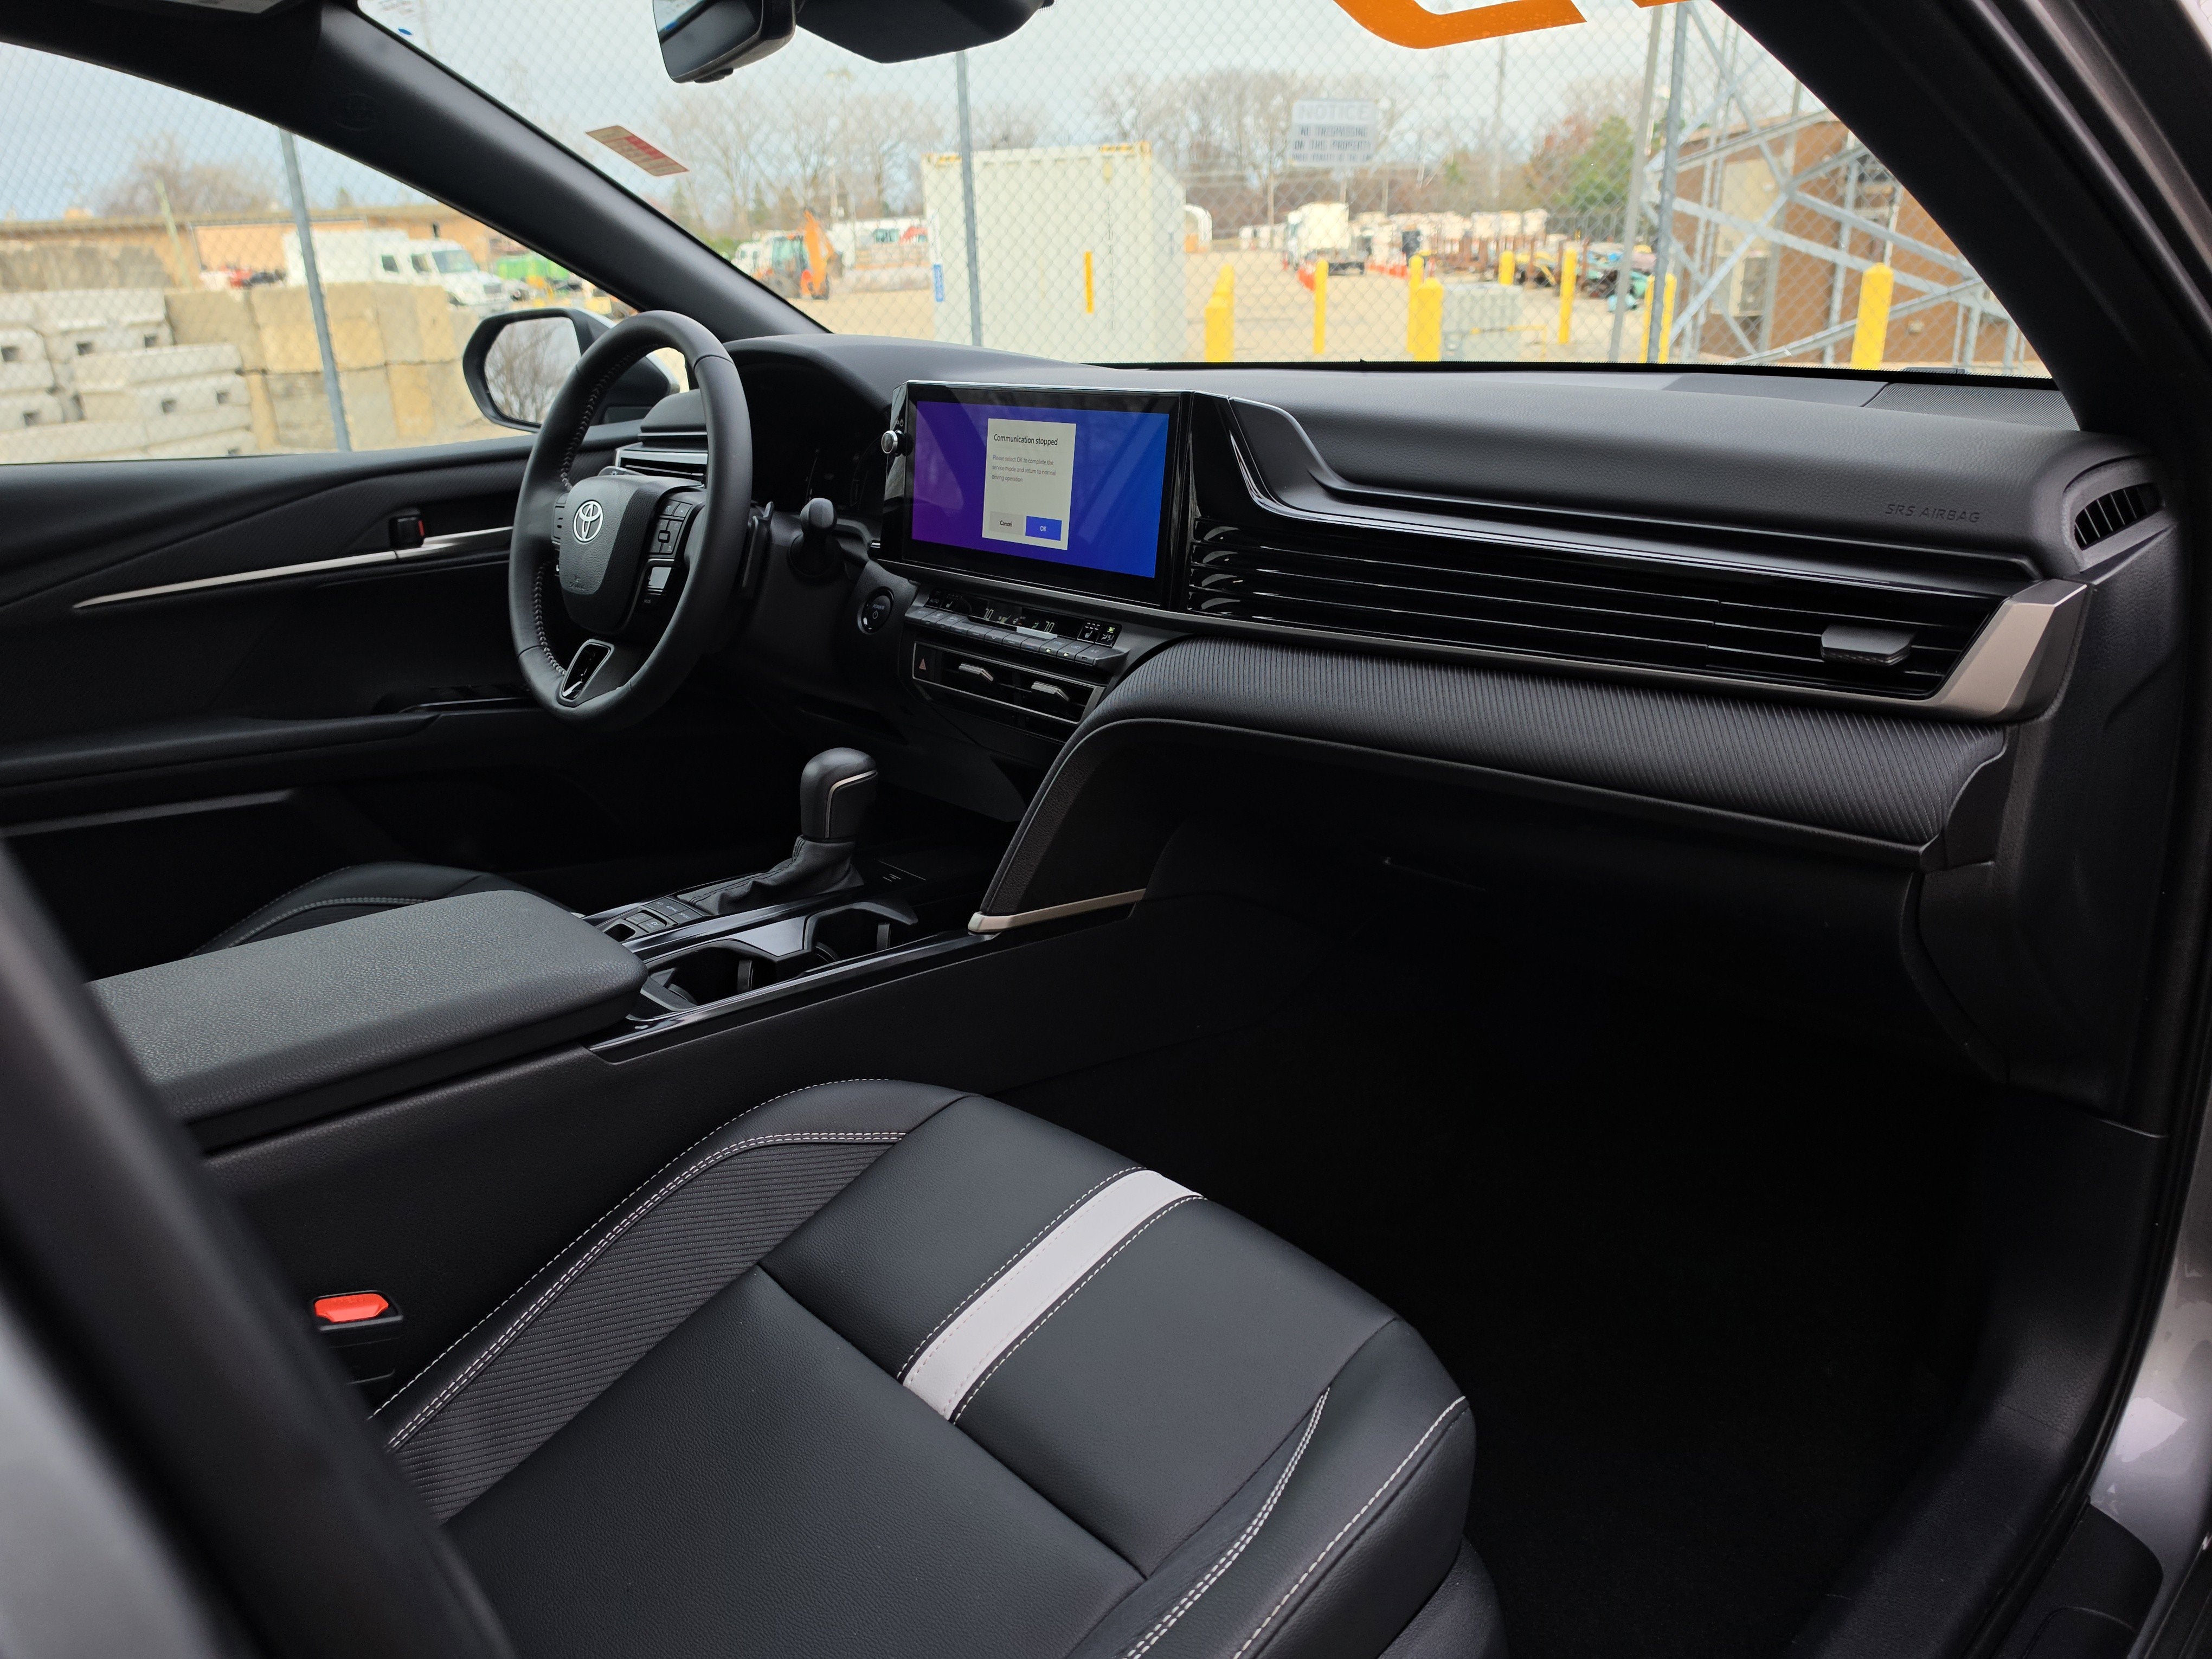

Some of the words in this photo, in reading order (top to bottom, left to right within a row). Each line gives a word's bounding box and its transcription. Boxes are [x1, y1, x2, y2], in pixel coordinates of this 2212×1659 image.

[1297, 104, 1371, 120] NOTICE
[994, 434, 1034, 444] Communication
[1036, 438, 1058, 447] stopped
[992, 474, 1004, 482] driving
[1885, 504, 1915, 516] SRS
[1919, 507, 1980, 523] AIRBAG
